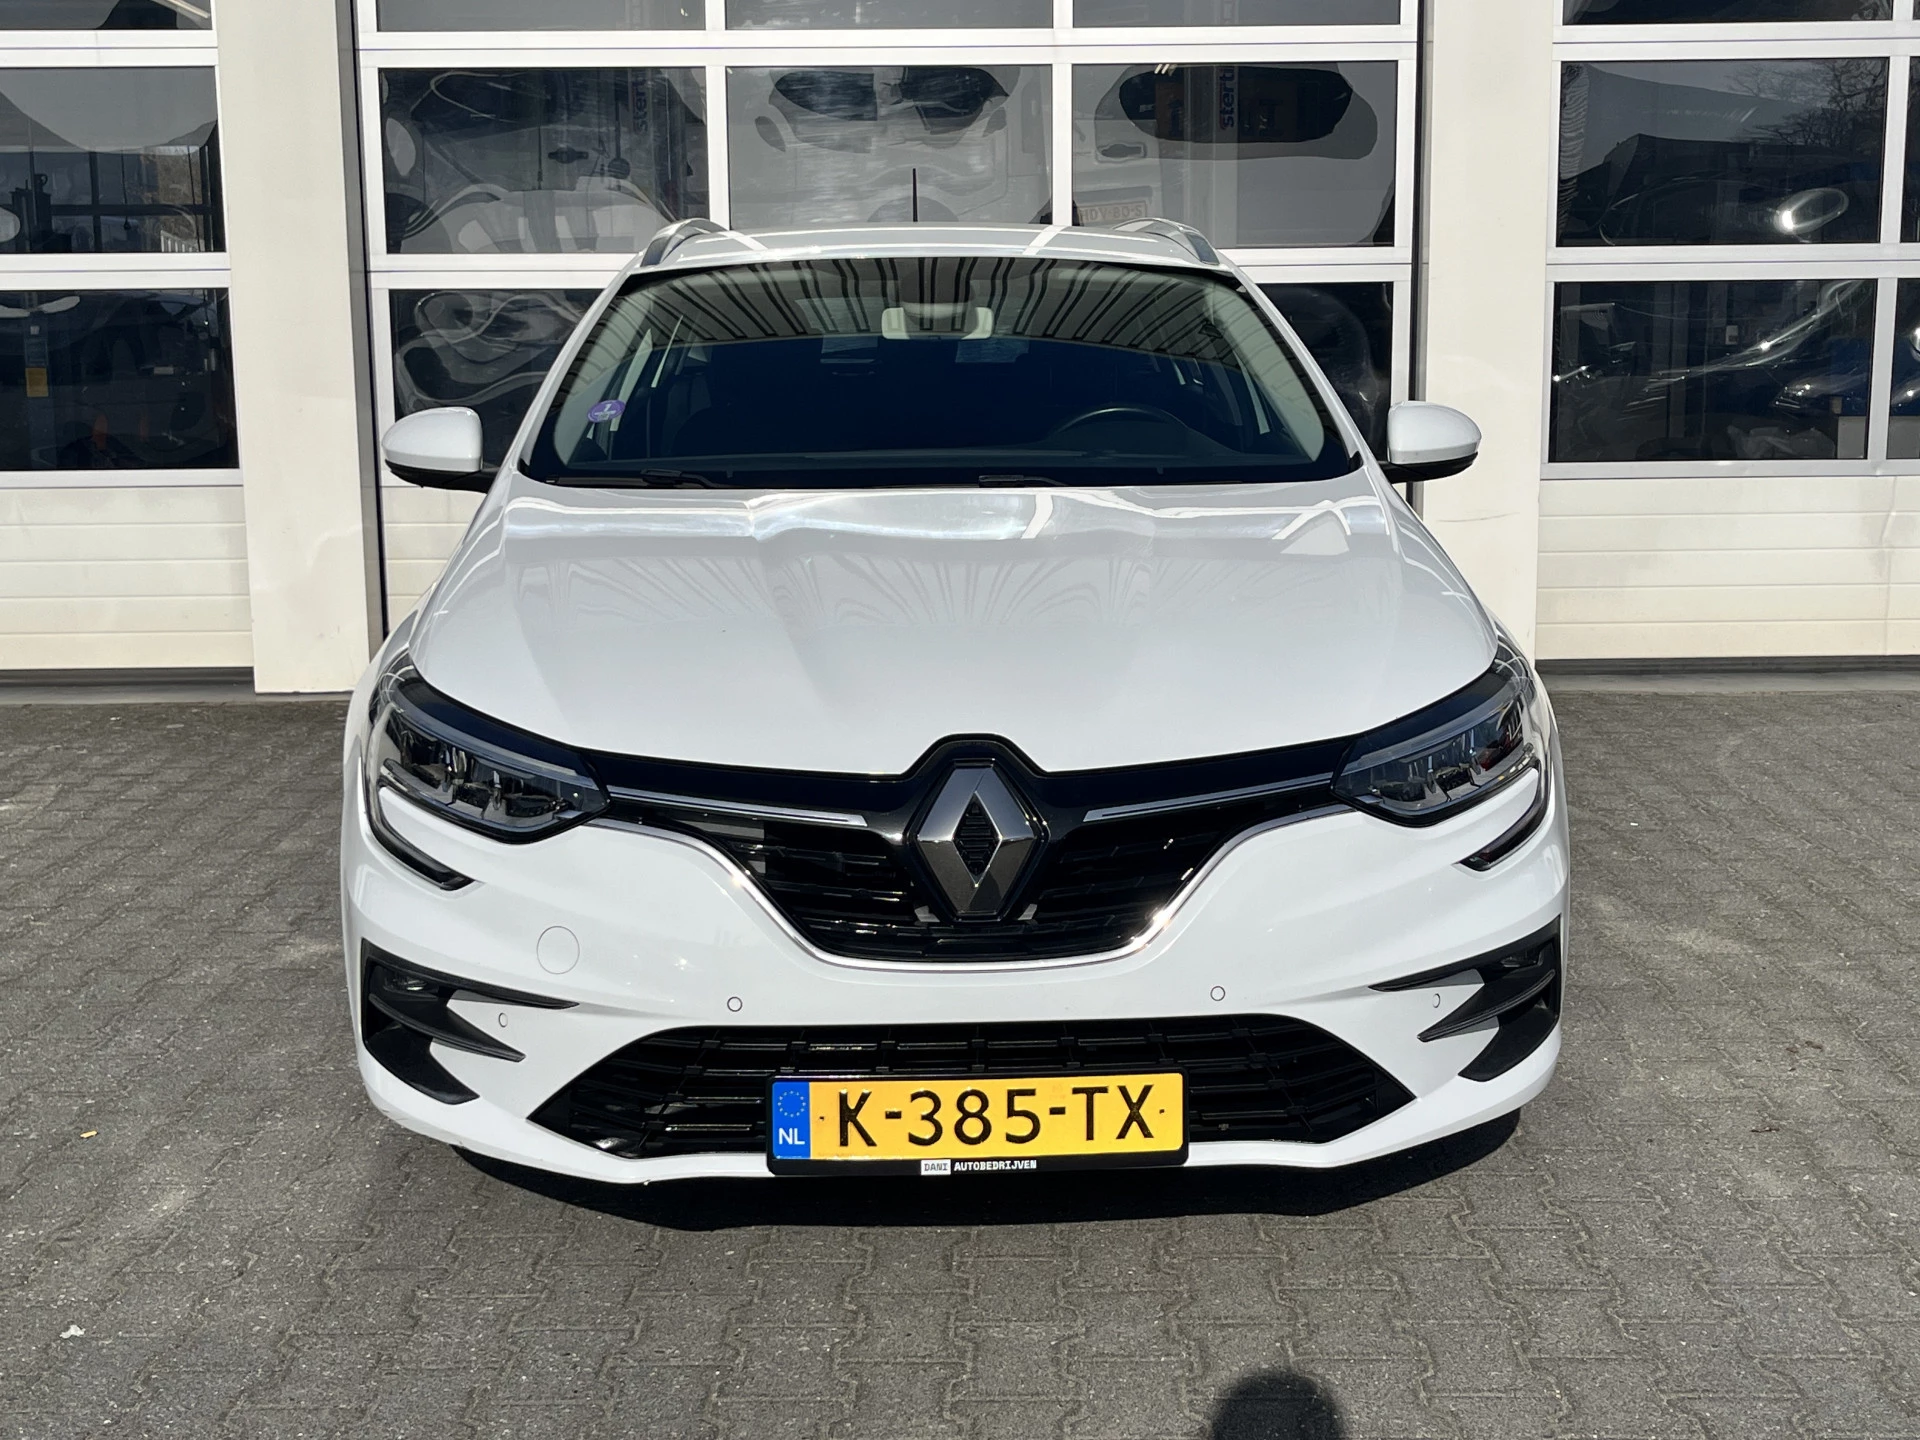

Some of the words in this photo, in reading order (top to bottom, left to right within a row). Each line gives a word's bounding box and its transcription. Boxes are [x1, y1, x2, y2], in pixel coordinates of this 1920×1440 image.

[838, 1084, 1154, 1148] K-385-TX
[778, 1127, 805, 1145] NL
[924, 1162, 948, 1171] DANI
[953, 1160, 1037, 1171] AUTOBEDRIJVEN
